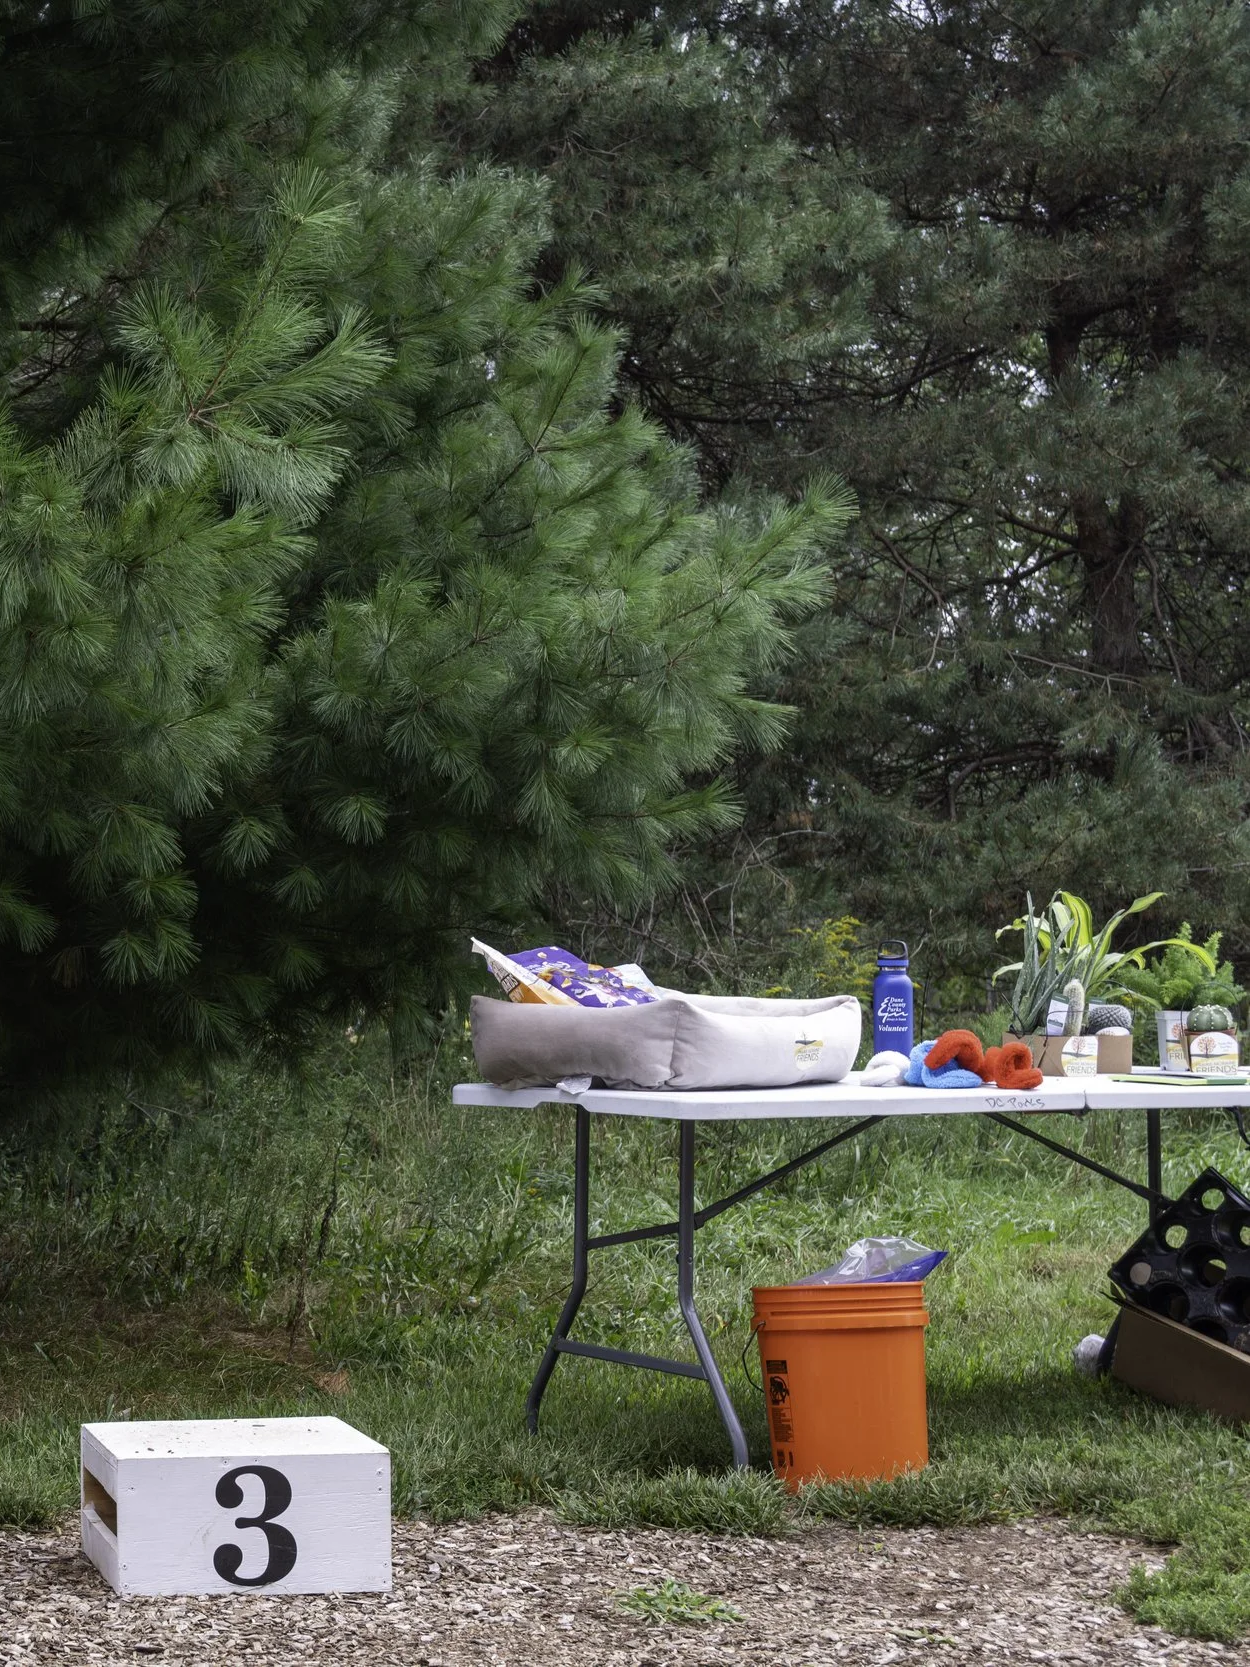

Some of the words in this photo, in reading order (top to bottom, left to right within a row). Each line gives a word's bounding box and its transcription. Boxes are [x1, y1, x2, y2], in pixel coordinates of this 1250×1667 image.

[1066, 1065, 1096, 1074] FRIENDS
[1196, 1065, 1237, 1073] FRIENDS
[985, 1097, 1005, 1108] DC
[214, 1466, 298, 1587] 3
